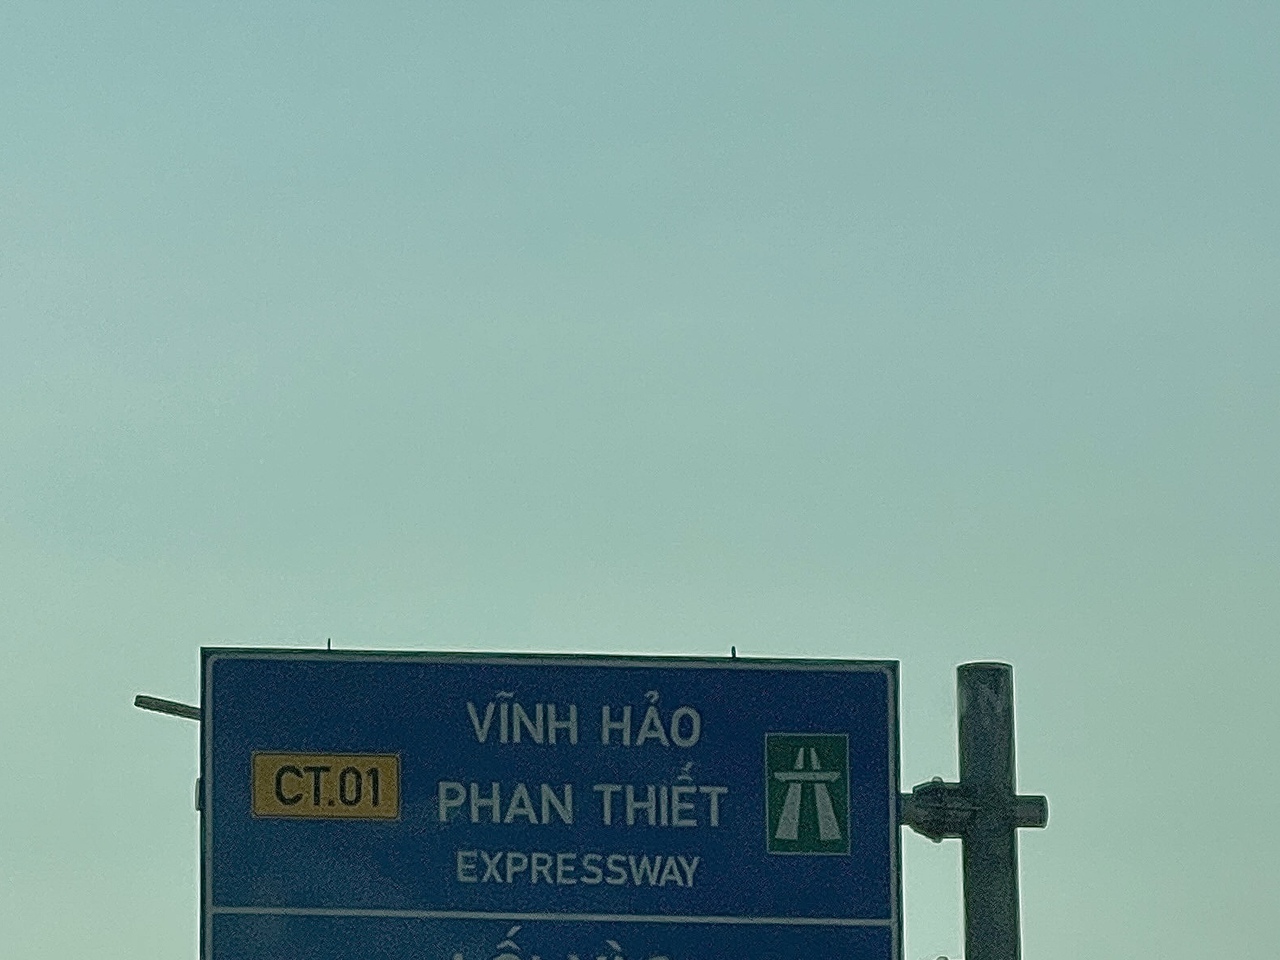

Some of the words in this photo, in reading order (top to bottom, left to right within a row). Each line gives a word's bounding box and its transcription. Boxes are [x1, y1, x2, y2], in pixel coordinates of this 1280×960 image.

[466, 691, 578, 745] VĨNH
[601, 690, 702, 748] HẢO
[274, 764, 380, 807] CT.01
[438, 780, 573, 826] PHAN
[593, 761, 729, 828] THIẾT
[456, 850, 701, 888] EXPRESSWAY
